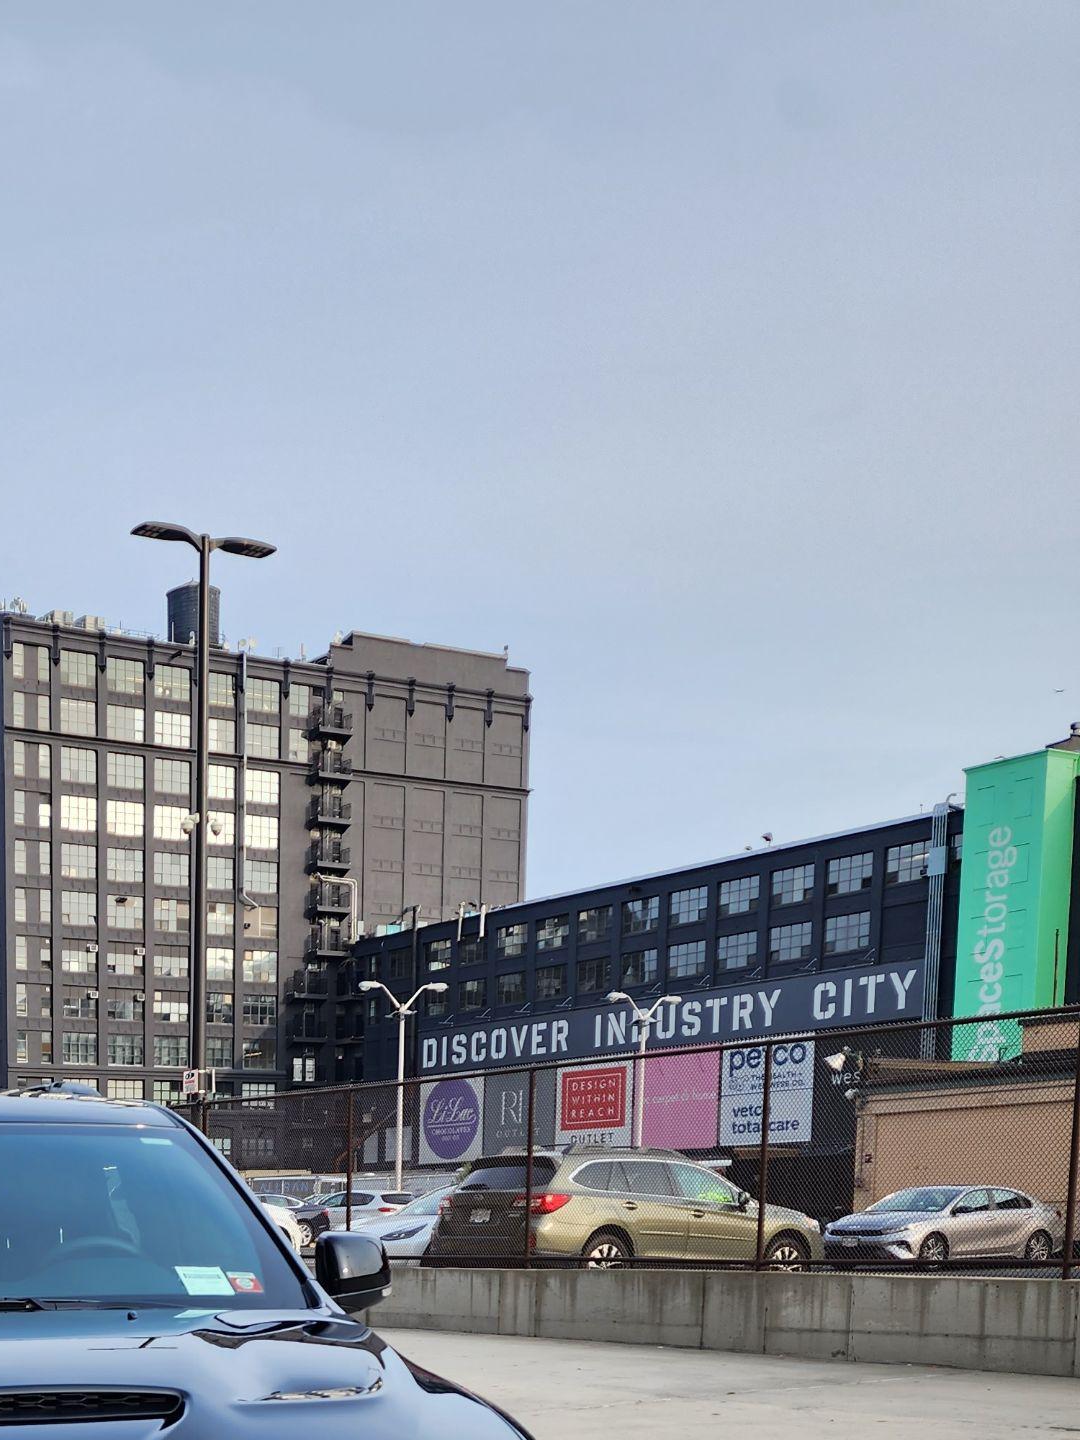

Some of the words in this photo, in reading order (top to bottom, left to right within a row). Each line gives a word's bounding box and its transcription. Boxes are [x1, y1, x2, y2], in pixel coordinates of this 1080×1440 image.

[422, 1019, 569, 1069] DISCOVER
[594, 988, 782, 1048] INDUSTRY
[812, 969, 918, 1021] CITY
[729, 1043, 807, 1077] peco
[572, 1078, 617, 1092] DESIGN
[571, 1093, 615, 1104] WITHIN
[570, 1107, 614, 1119] REACH
[732, 1105, 762, 1118] vetc
[496, 1127, 541, 1139] OUTLT
[732, 1120, 761, 1134] tota
[768, 1119, 800, 1132] care
[570, 1131, 615, 1144] OUTLET
